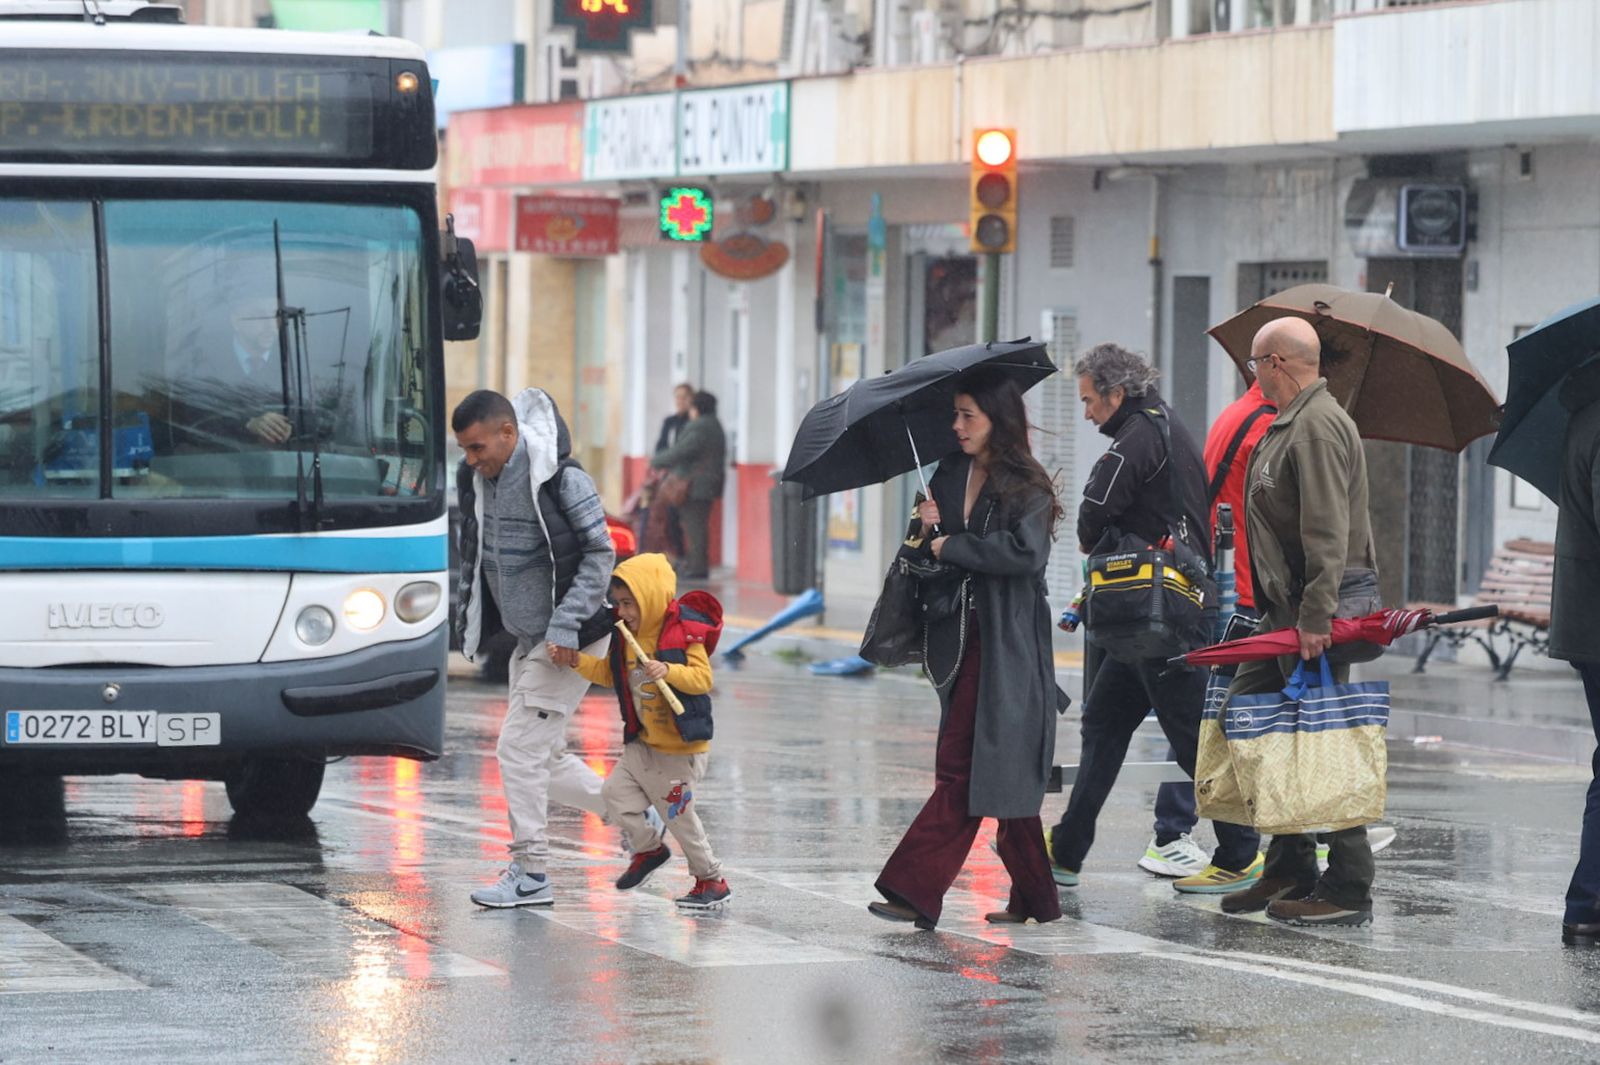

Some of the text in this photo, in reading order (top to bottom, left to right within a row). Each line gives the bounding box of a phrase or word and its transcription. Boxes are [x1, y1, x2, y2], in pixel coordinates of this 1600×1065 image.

[48, 603, 164, 629] IVECO
[25, 715, 91, 738] 0272
[101, 714, 151, 738] BLY
